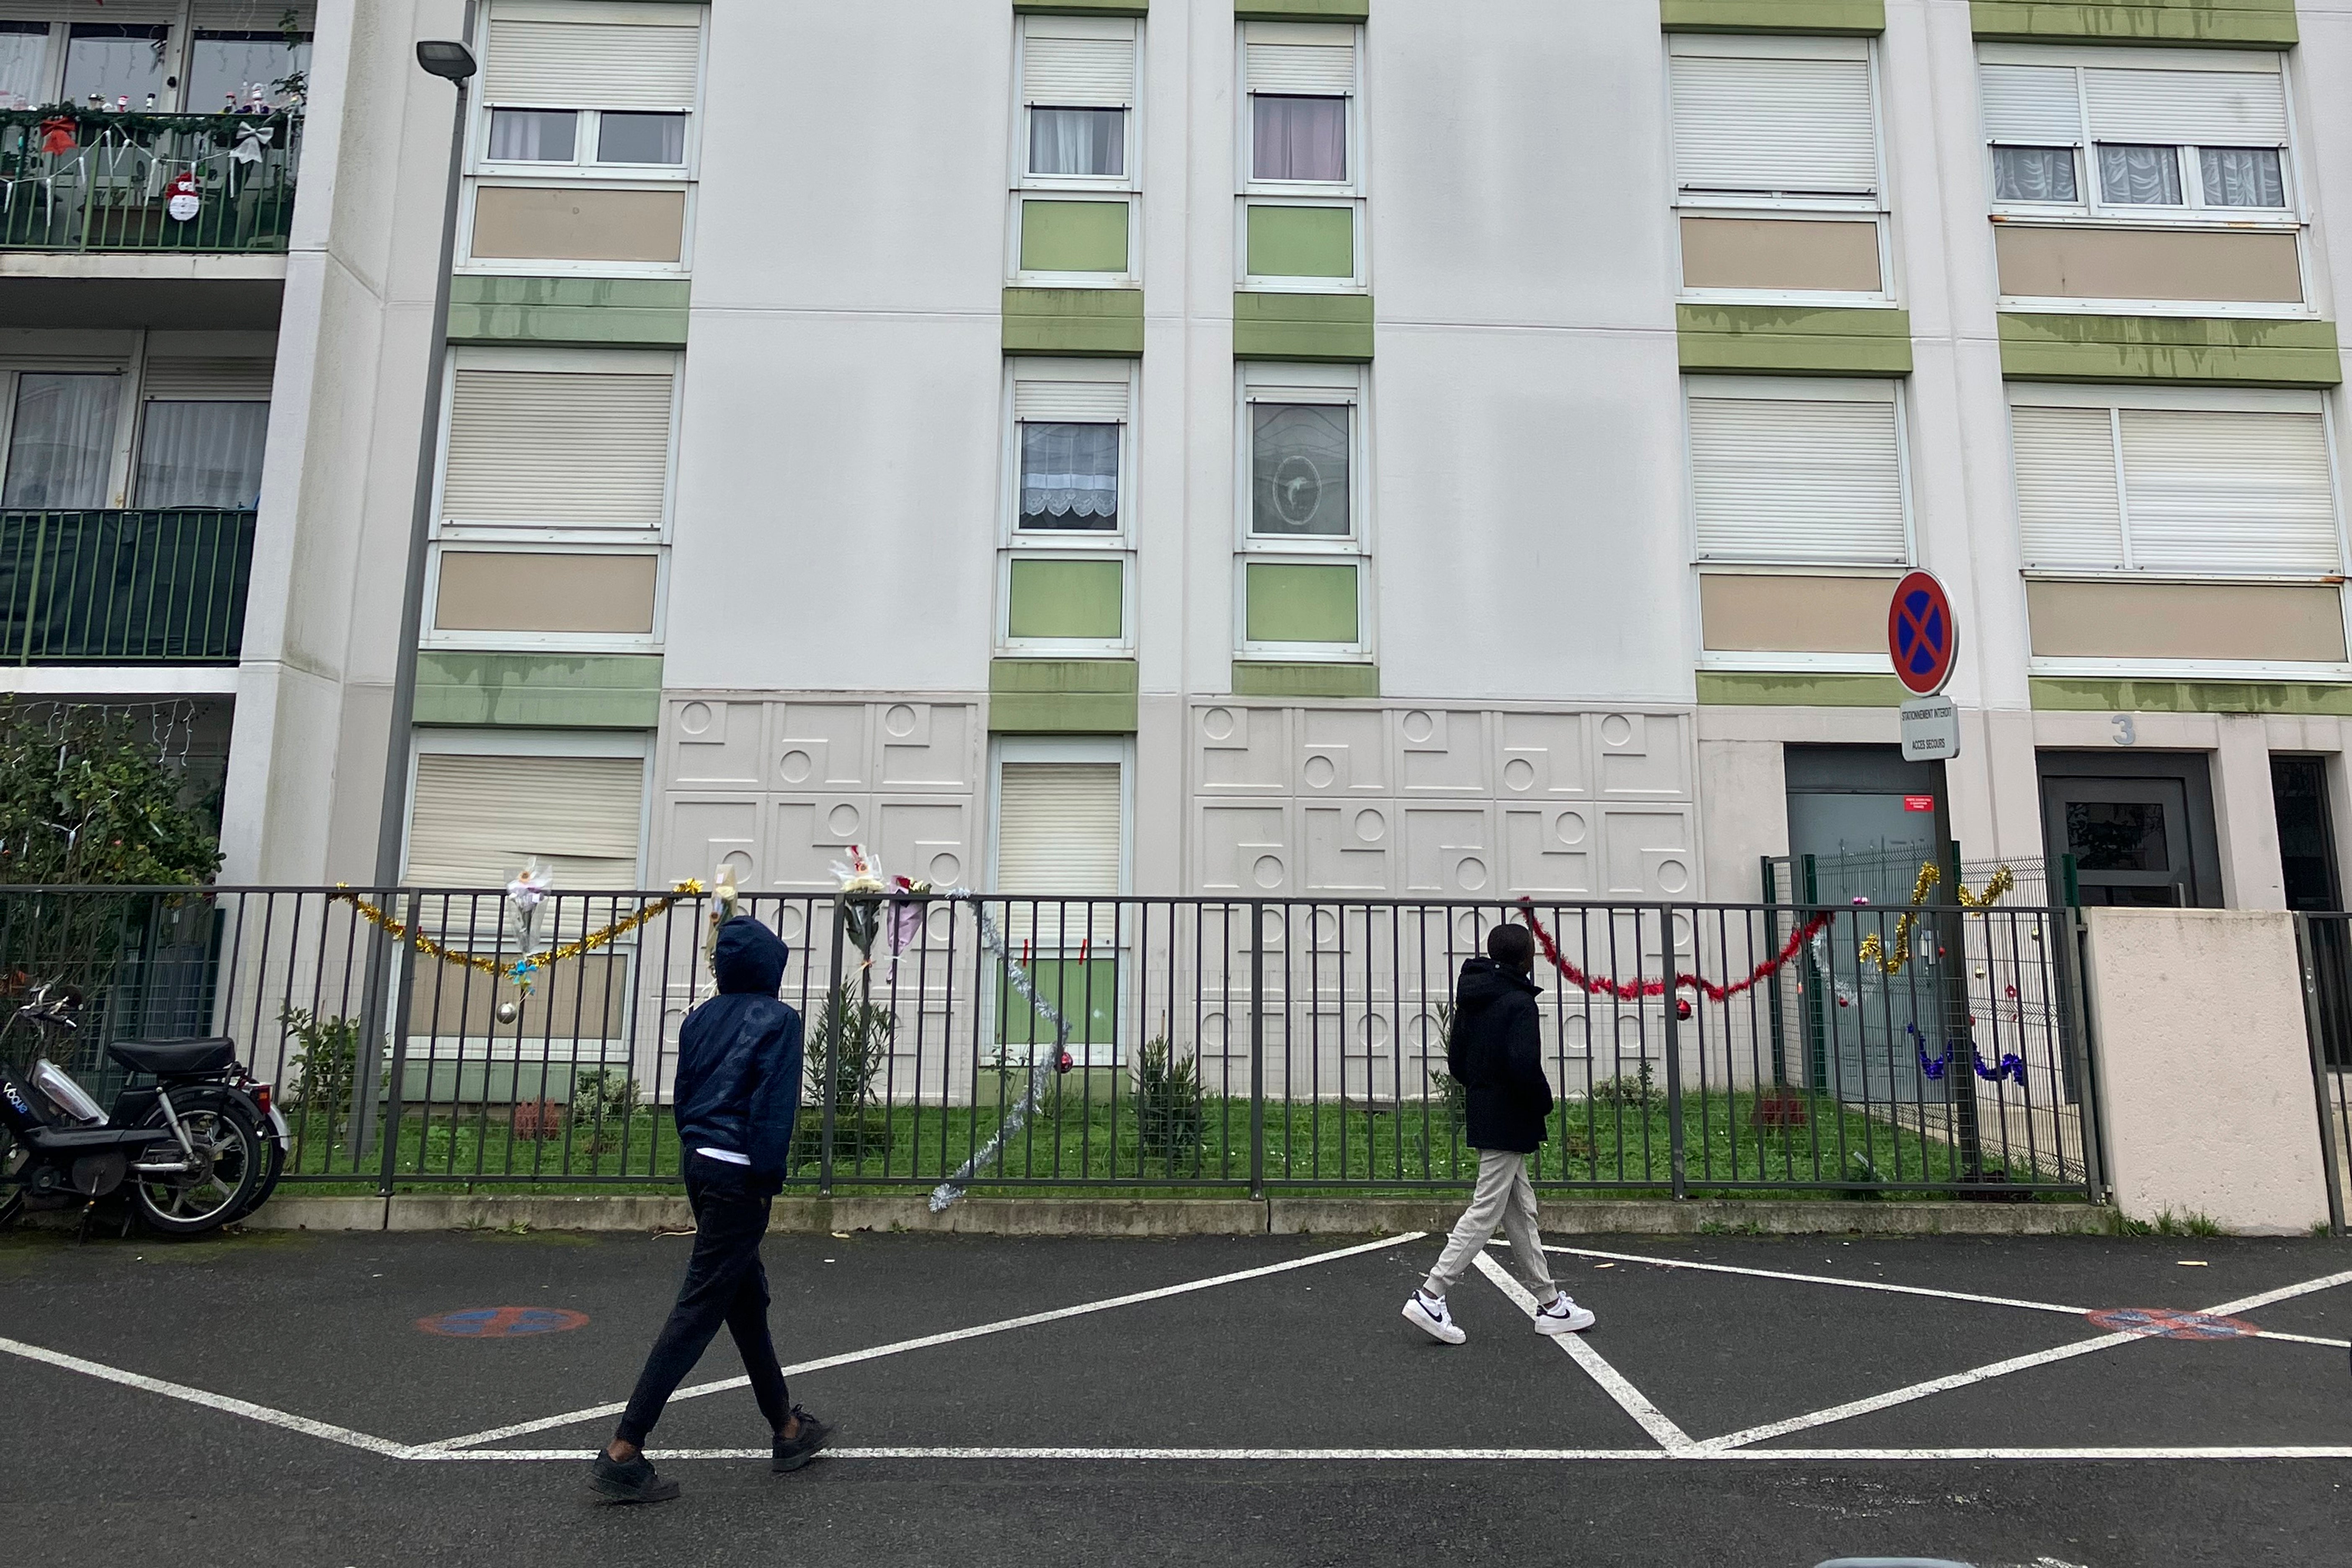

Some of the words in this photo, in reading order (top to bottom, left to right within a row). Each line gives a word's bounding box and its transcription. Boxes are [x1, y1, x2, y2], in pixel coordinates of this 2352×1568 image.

[1902, 709, 1933, 721] STATIONNEMENT
[1934, 707, 1952, 718] INTERDIT
[2112, 714, 2135, 745] 3
[1926, 738, 1945, 749] SECOURS
